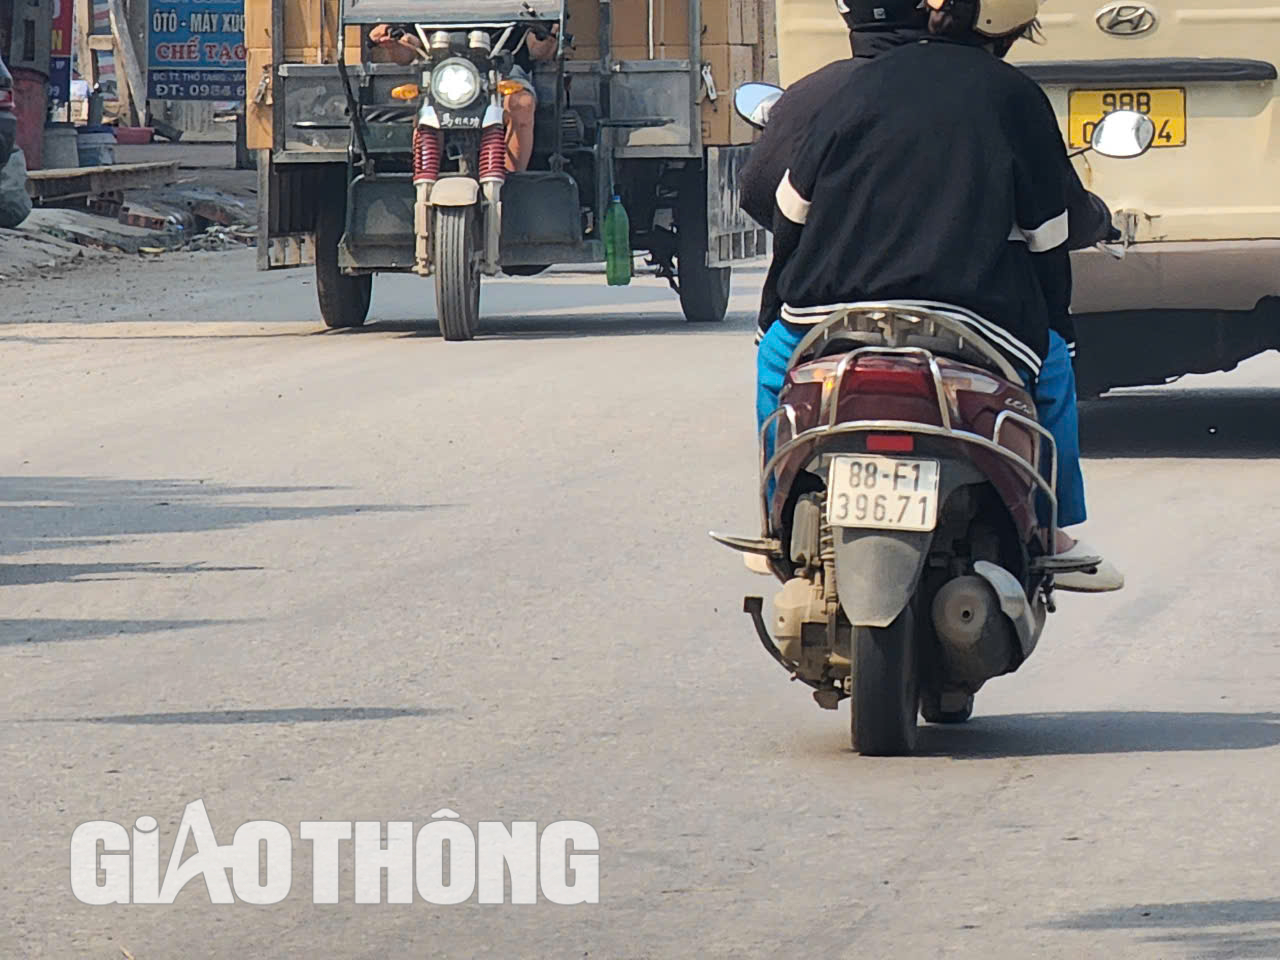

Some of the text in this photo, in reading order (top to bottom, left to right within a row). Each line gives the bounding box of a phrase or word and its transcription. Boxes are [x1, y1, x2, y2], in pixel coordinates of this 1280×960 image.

[153, 8, 177, 33] ÔTÔ
[190, 9, 218, 33] MÁY
[156, 36, 247, 65] CHẾ TẠO
[849, 461, 920, 491] 88-F1
[836, 493, 927, 525] 396.71
